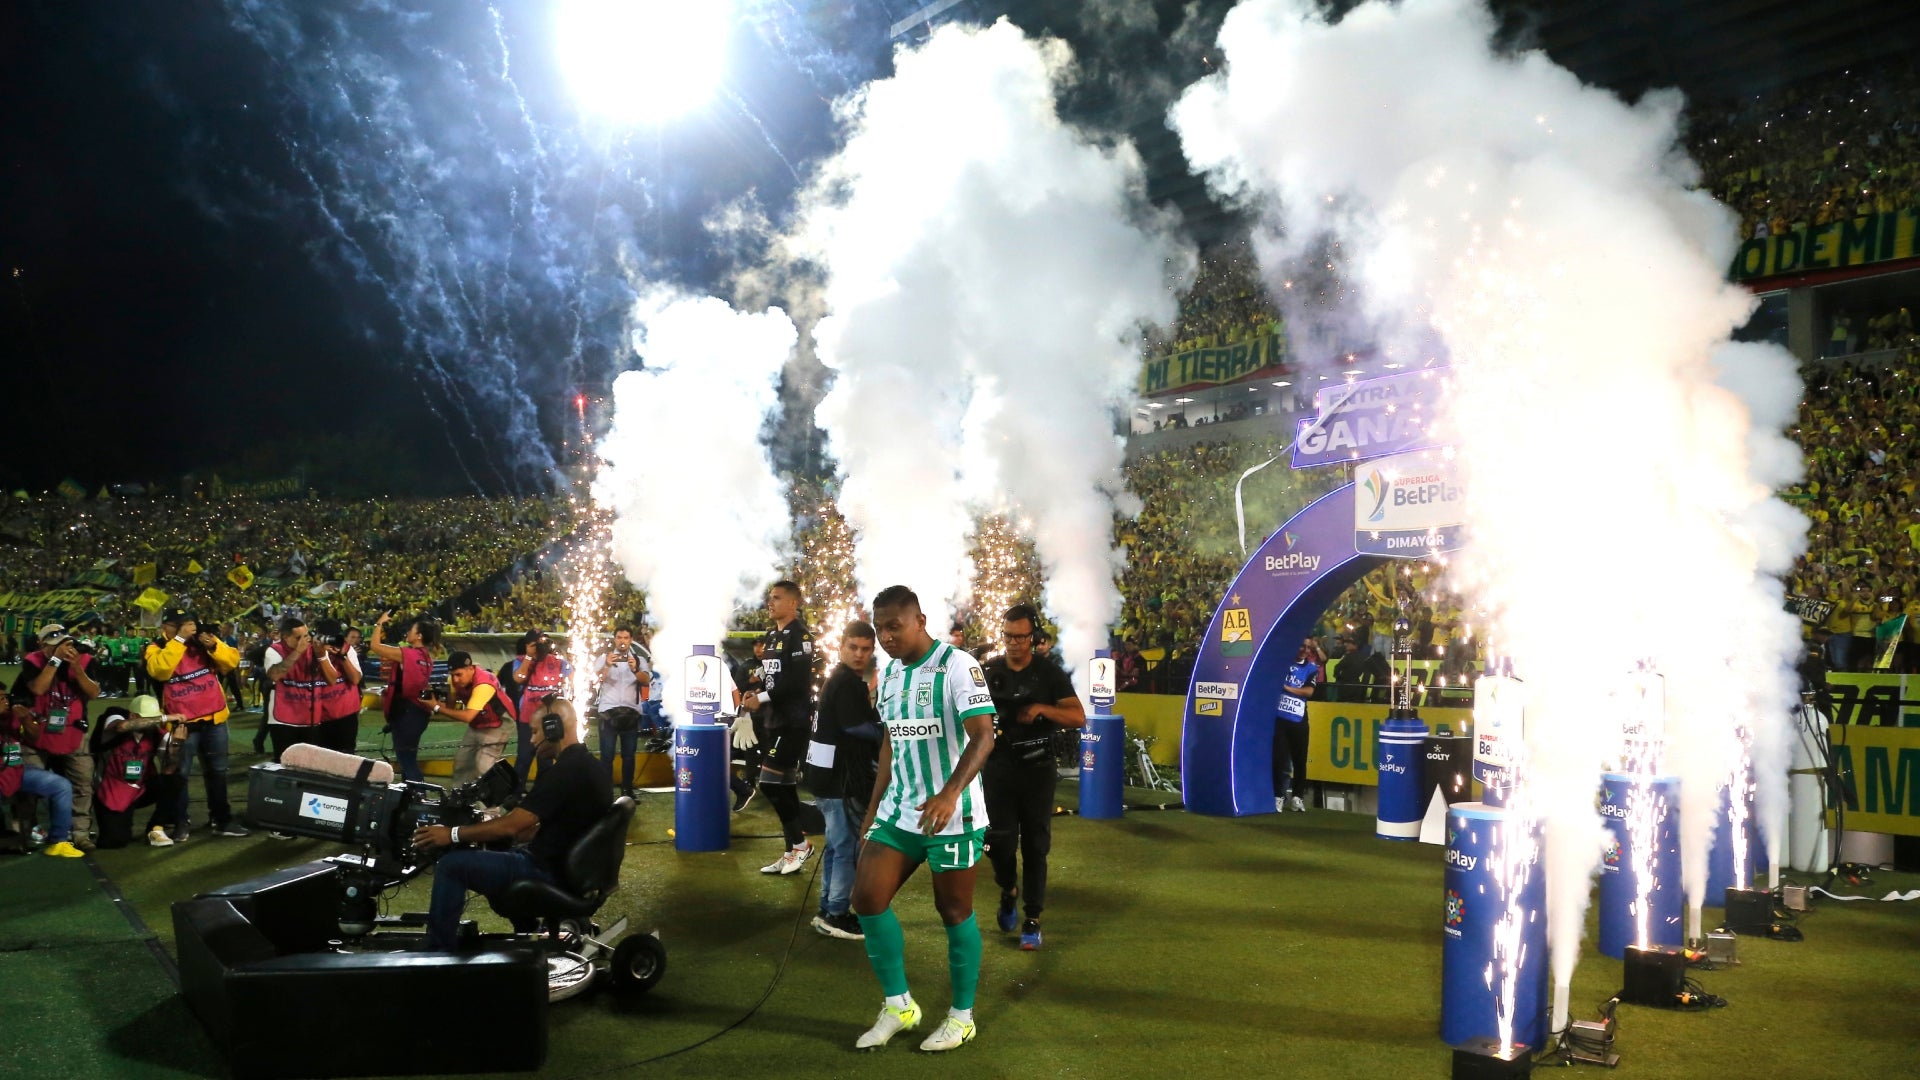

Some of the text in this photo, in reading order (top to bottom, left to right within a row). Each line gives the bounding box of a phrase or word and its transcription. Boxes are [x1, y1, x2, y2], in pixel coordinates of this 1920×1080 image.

[1146, 359, 1170, 392] MI
[1178, 340, 1261, 383] TIERRA
[1297, 410, 1421, 455] GANA
[1394, 475, 1440, 487] SUPERLIGA
[1387, 534, 1445, 549] DIMAYOR
[1265, 551, 1321, 571] BetPlay
[689, 690, 716, 700] BetPlay
[1197, 684, 1227, 696] BetPlay
[889, 723, 941, 738] etsson
[1426, 752, 1450, 761] GOLTY
[322, 802, 348, 812] torneo
